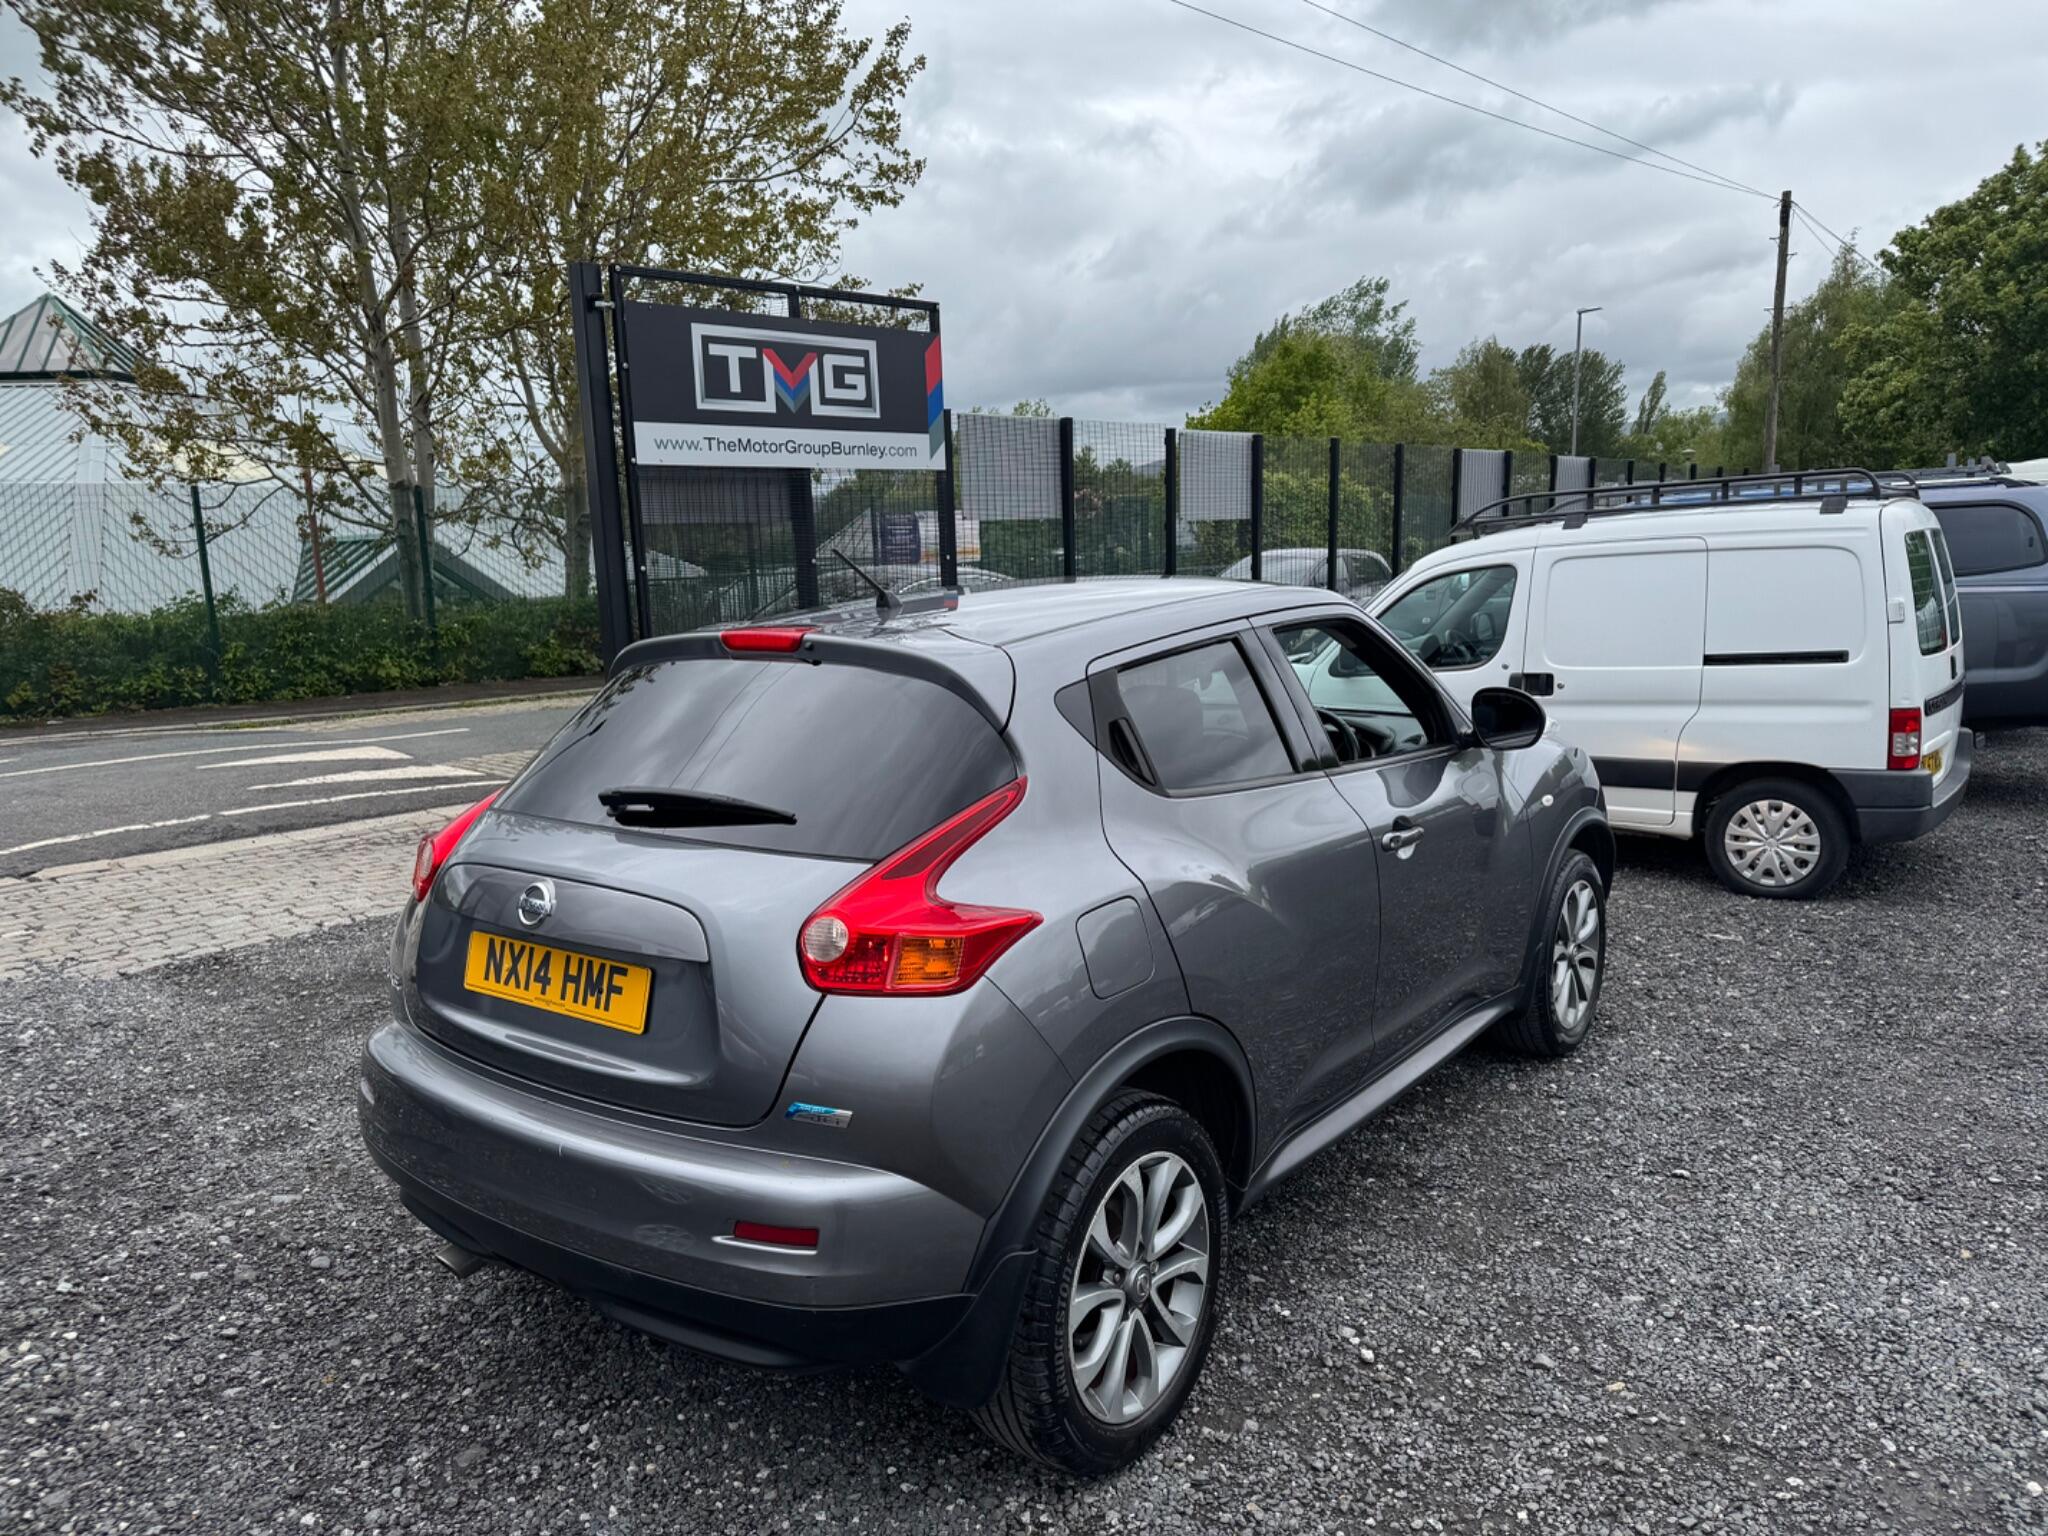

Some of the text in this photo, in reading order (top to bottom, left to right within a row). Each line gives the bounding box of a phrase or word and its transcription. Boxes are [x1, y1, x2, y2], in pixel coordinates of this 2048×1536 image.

[708, 342, 867, 414] TMG
[653, 436, 918, 459] www.TheMotorGroupBurnley.com
[483, 937, 629, 1012] NX14 HMF
